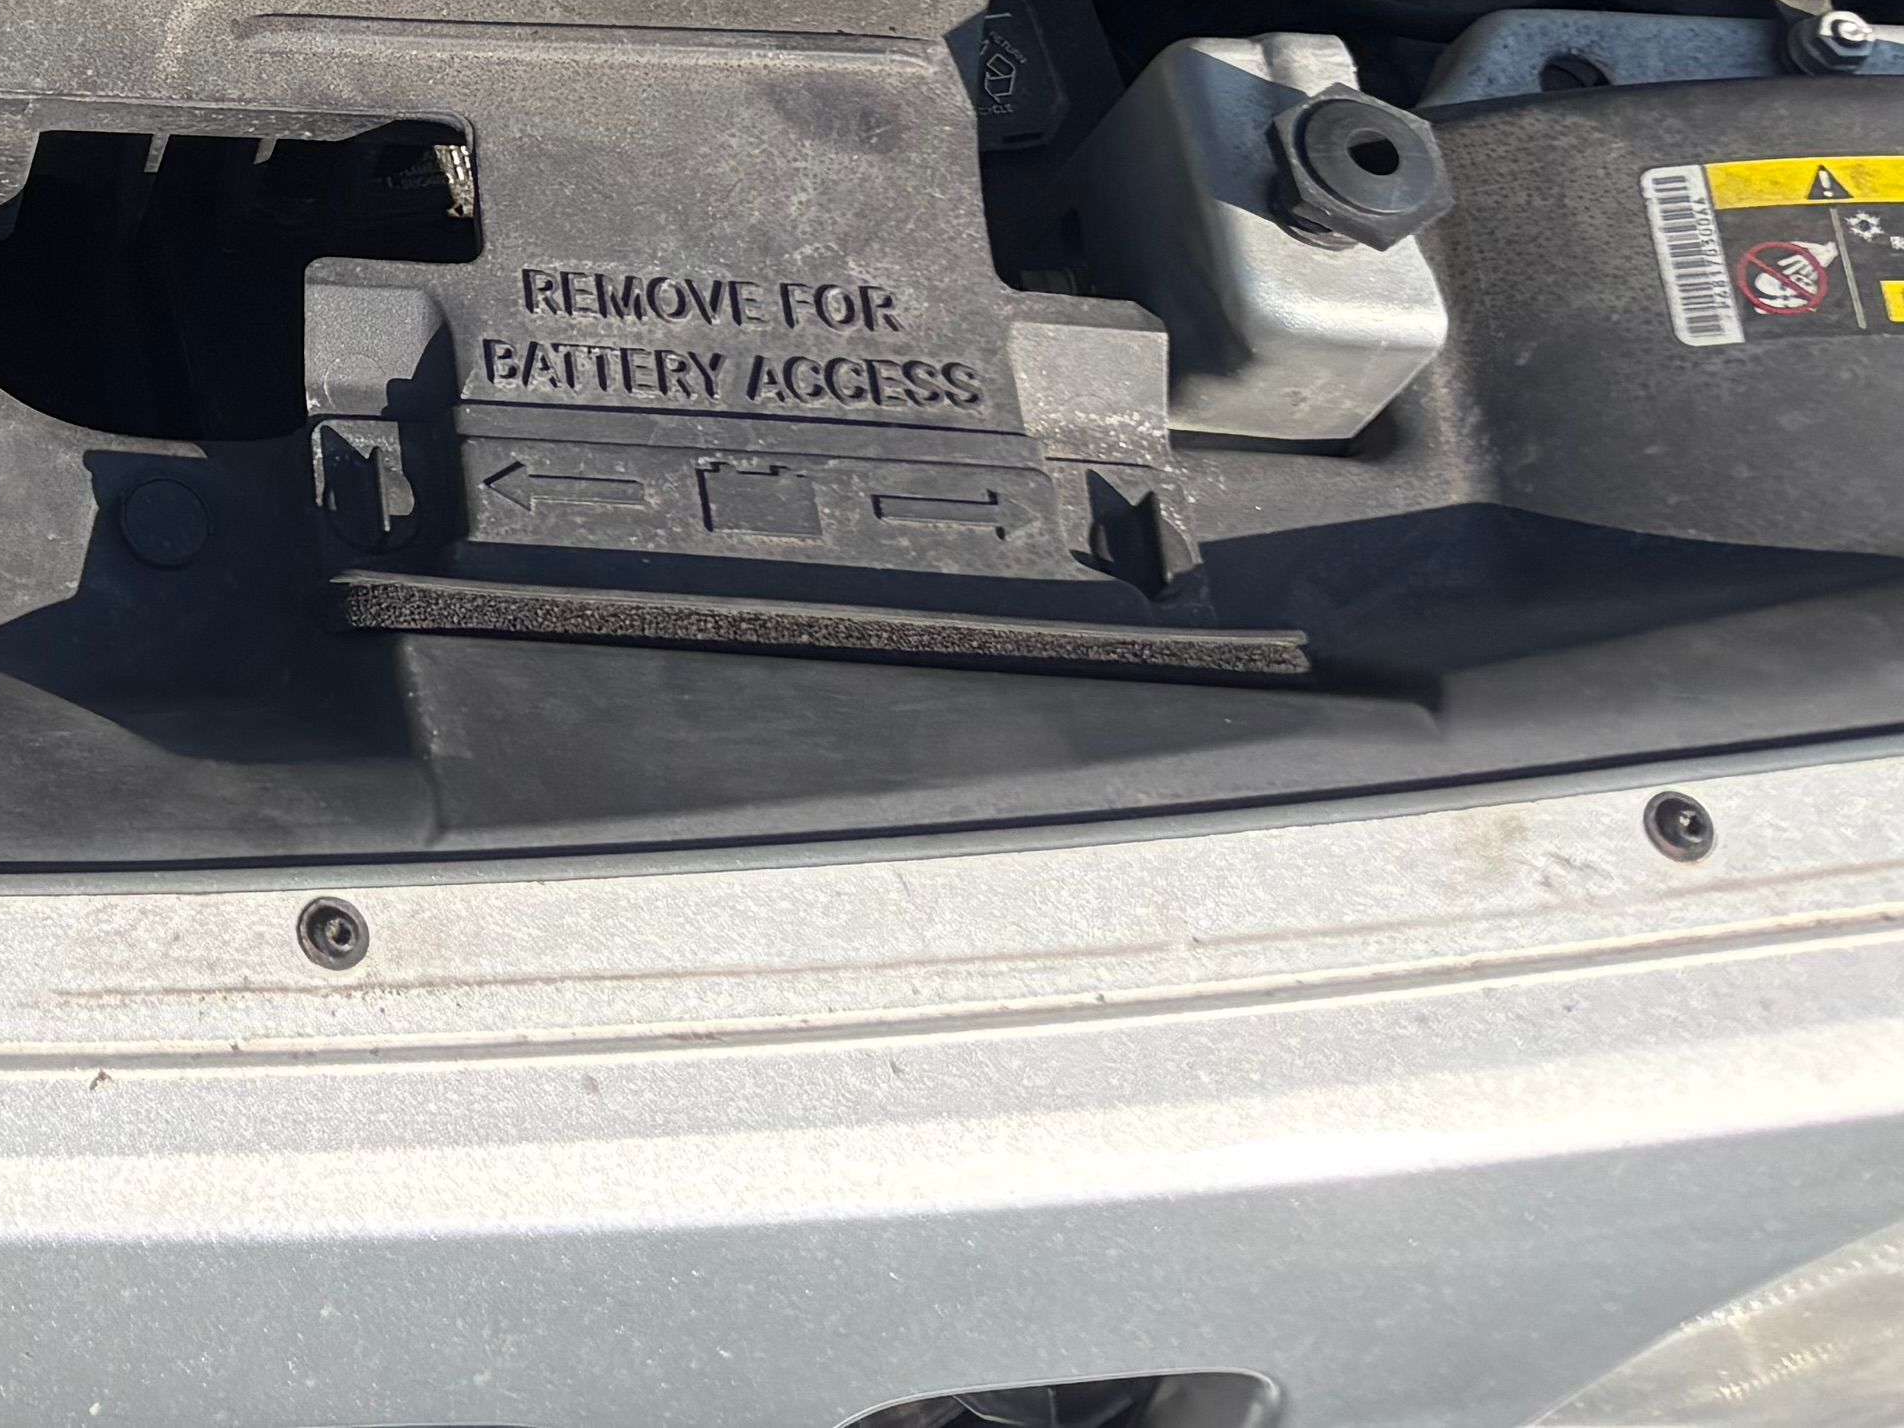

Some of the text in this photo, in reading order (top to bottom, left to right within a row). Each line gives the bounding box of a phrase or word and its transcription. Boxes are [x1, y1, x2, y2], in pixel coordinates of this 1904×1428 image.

[521, 267, 903, 333] REMOVE FOR
[482, 337, 983, 409] BATTERY ACCESS
